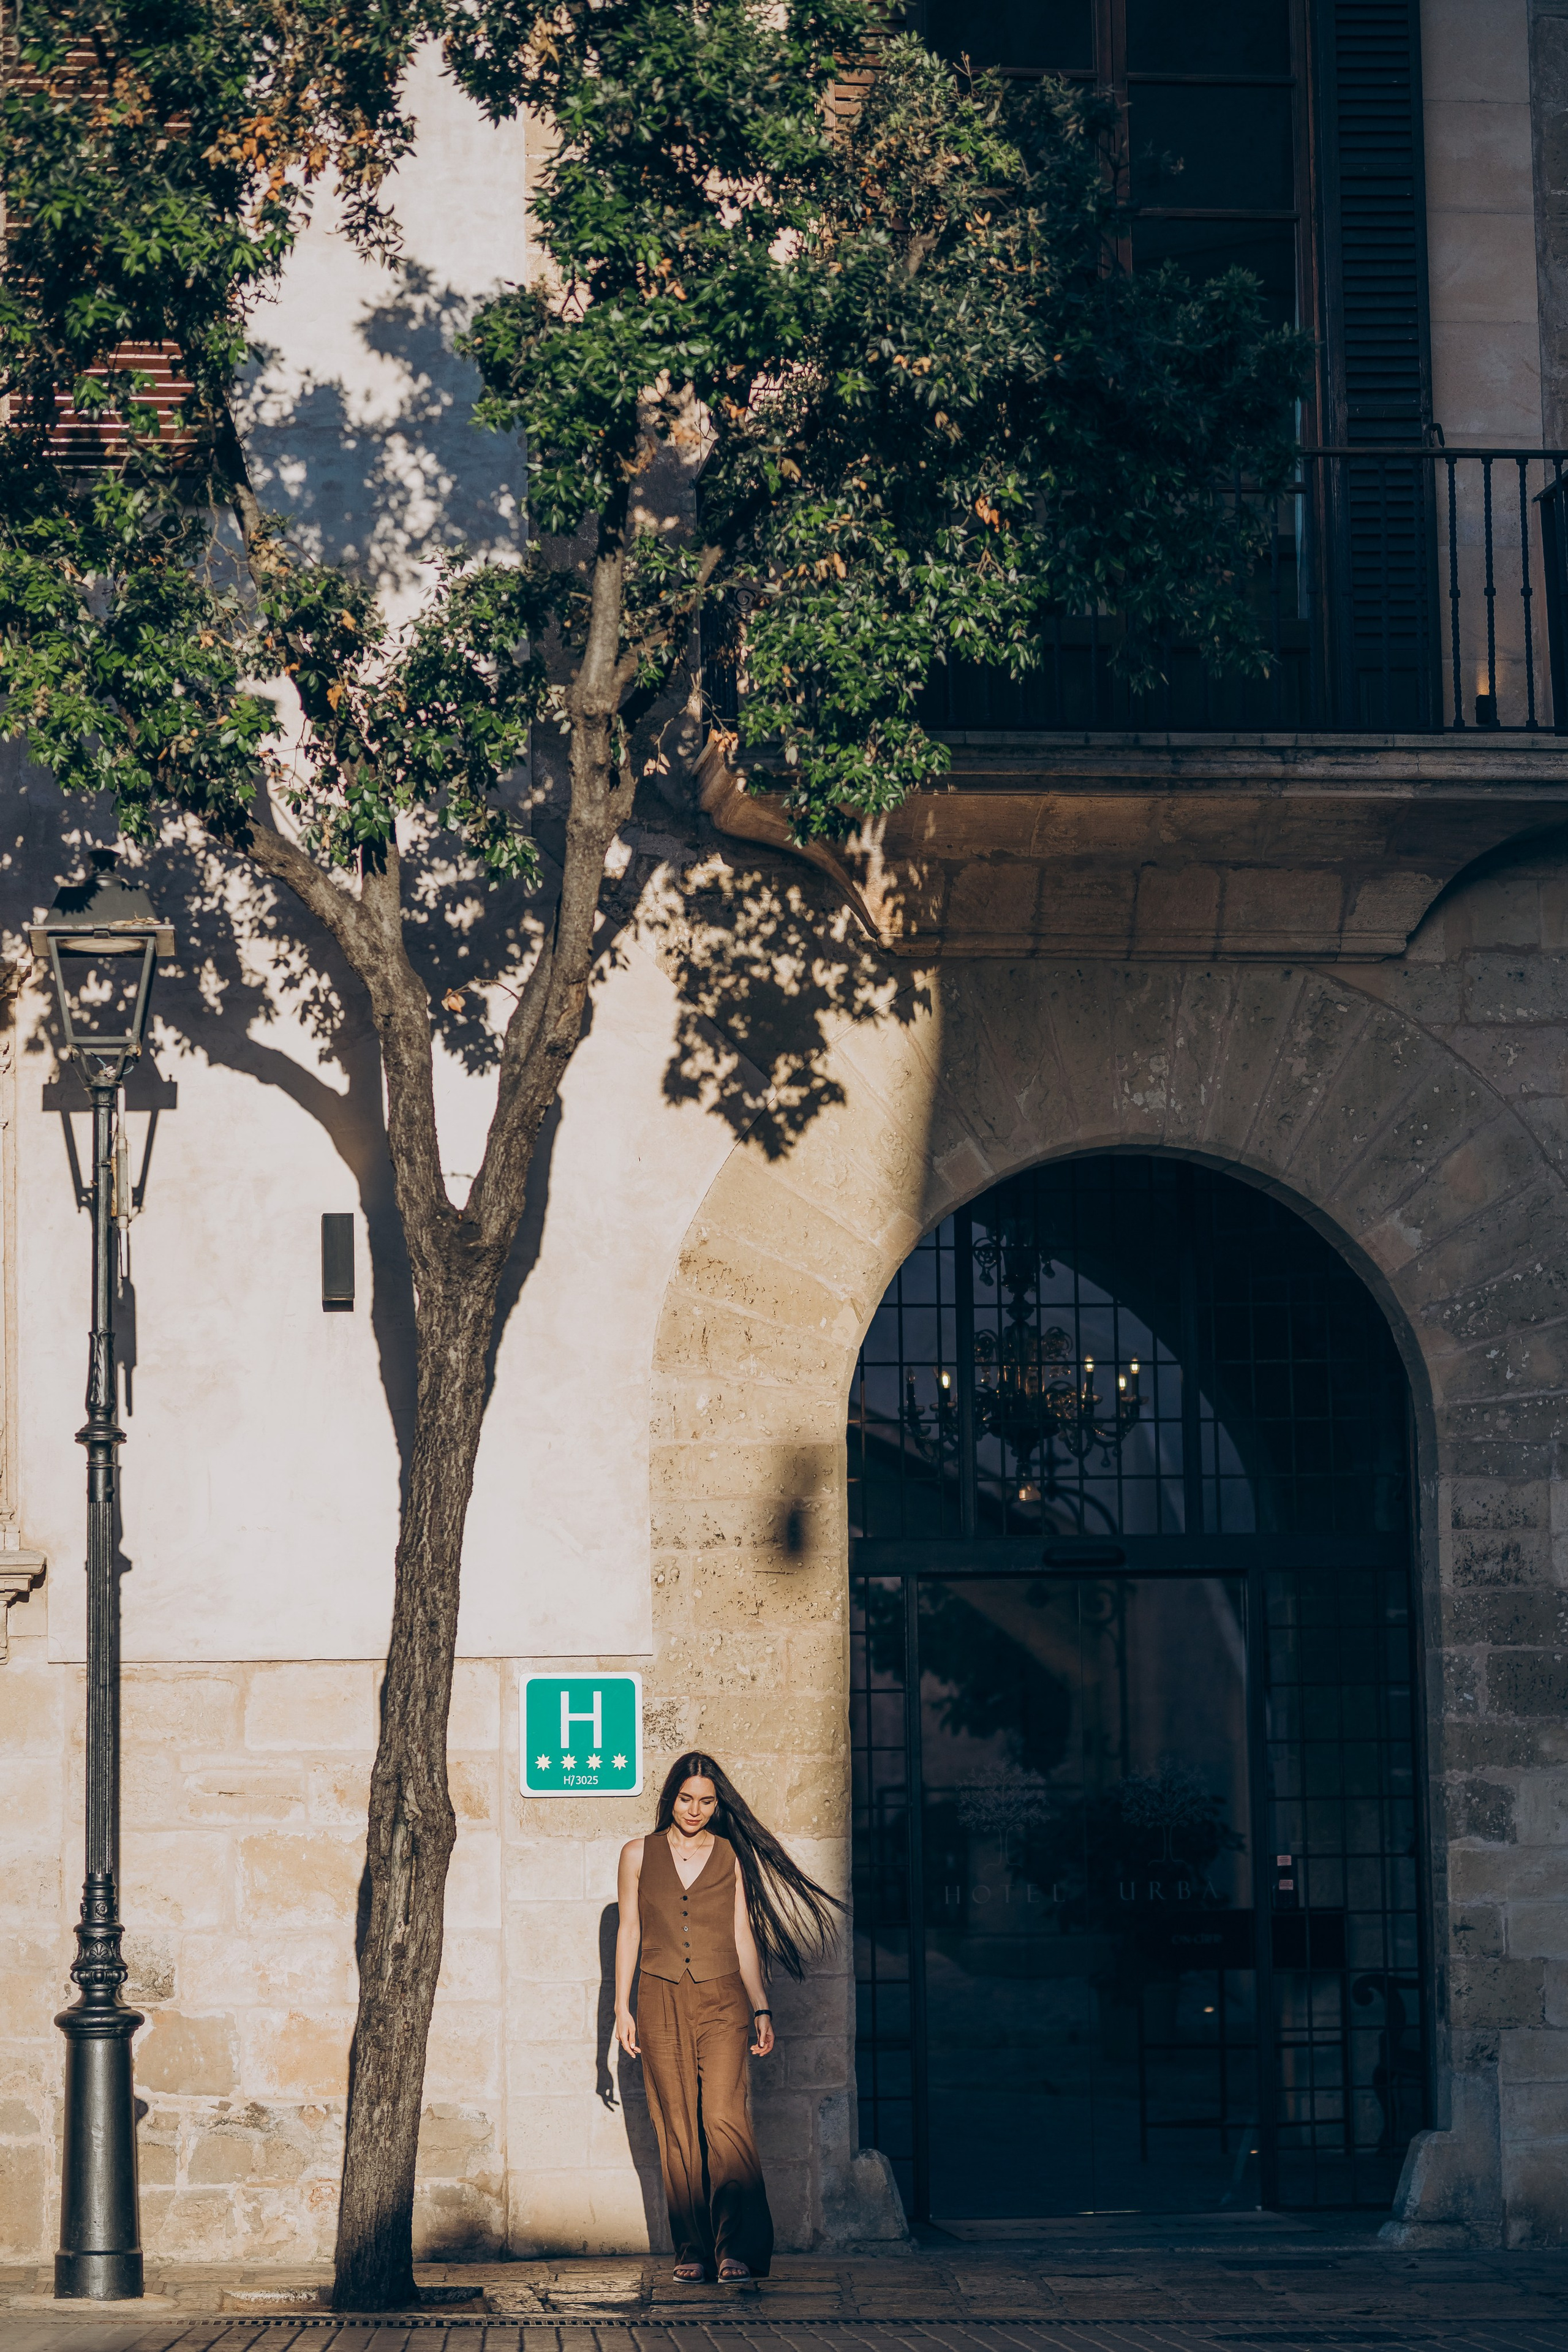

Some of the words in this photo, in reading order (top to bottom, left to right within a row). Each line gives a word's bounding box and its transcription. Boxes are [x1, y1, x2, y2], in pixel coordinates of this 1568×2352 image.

[560, 1691, 602, 1749] H
[564, 1775, 598, 1786] H/3025
[944, 1883, 1065, 1904] HOTEL
[1120, 1875, 1219, 1901] URBÀ
